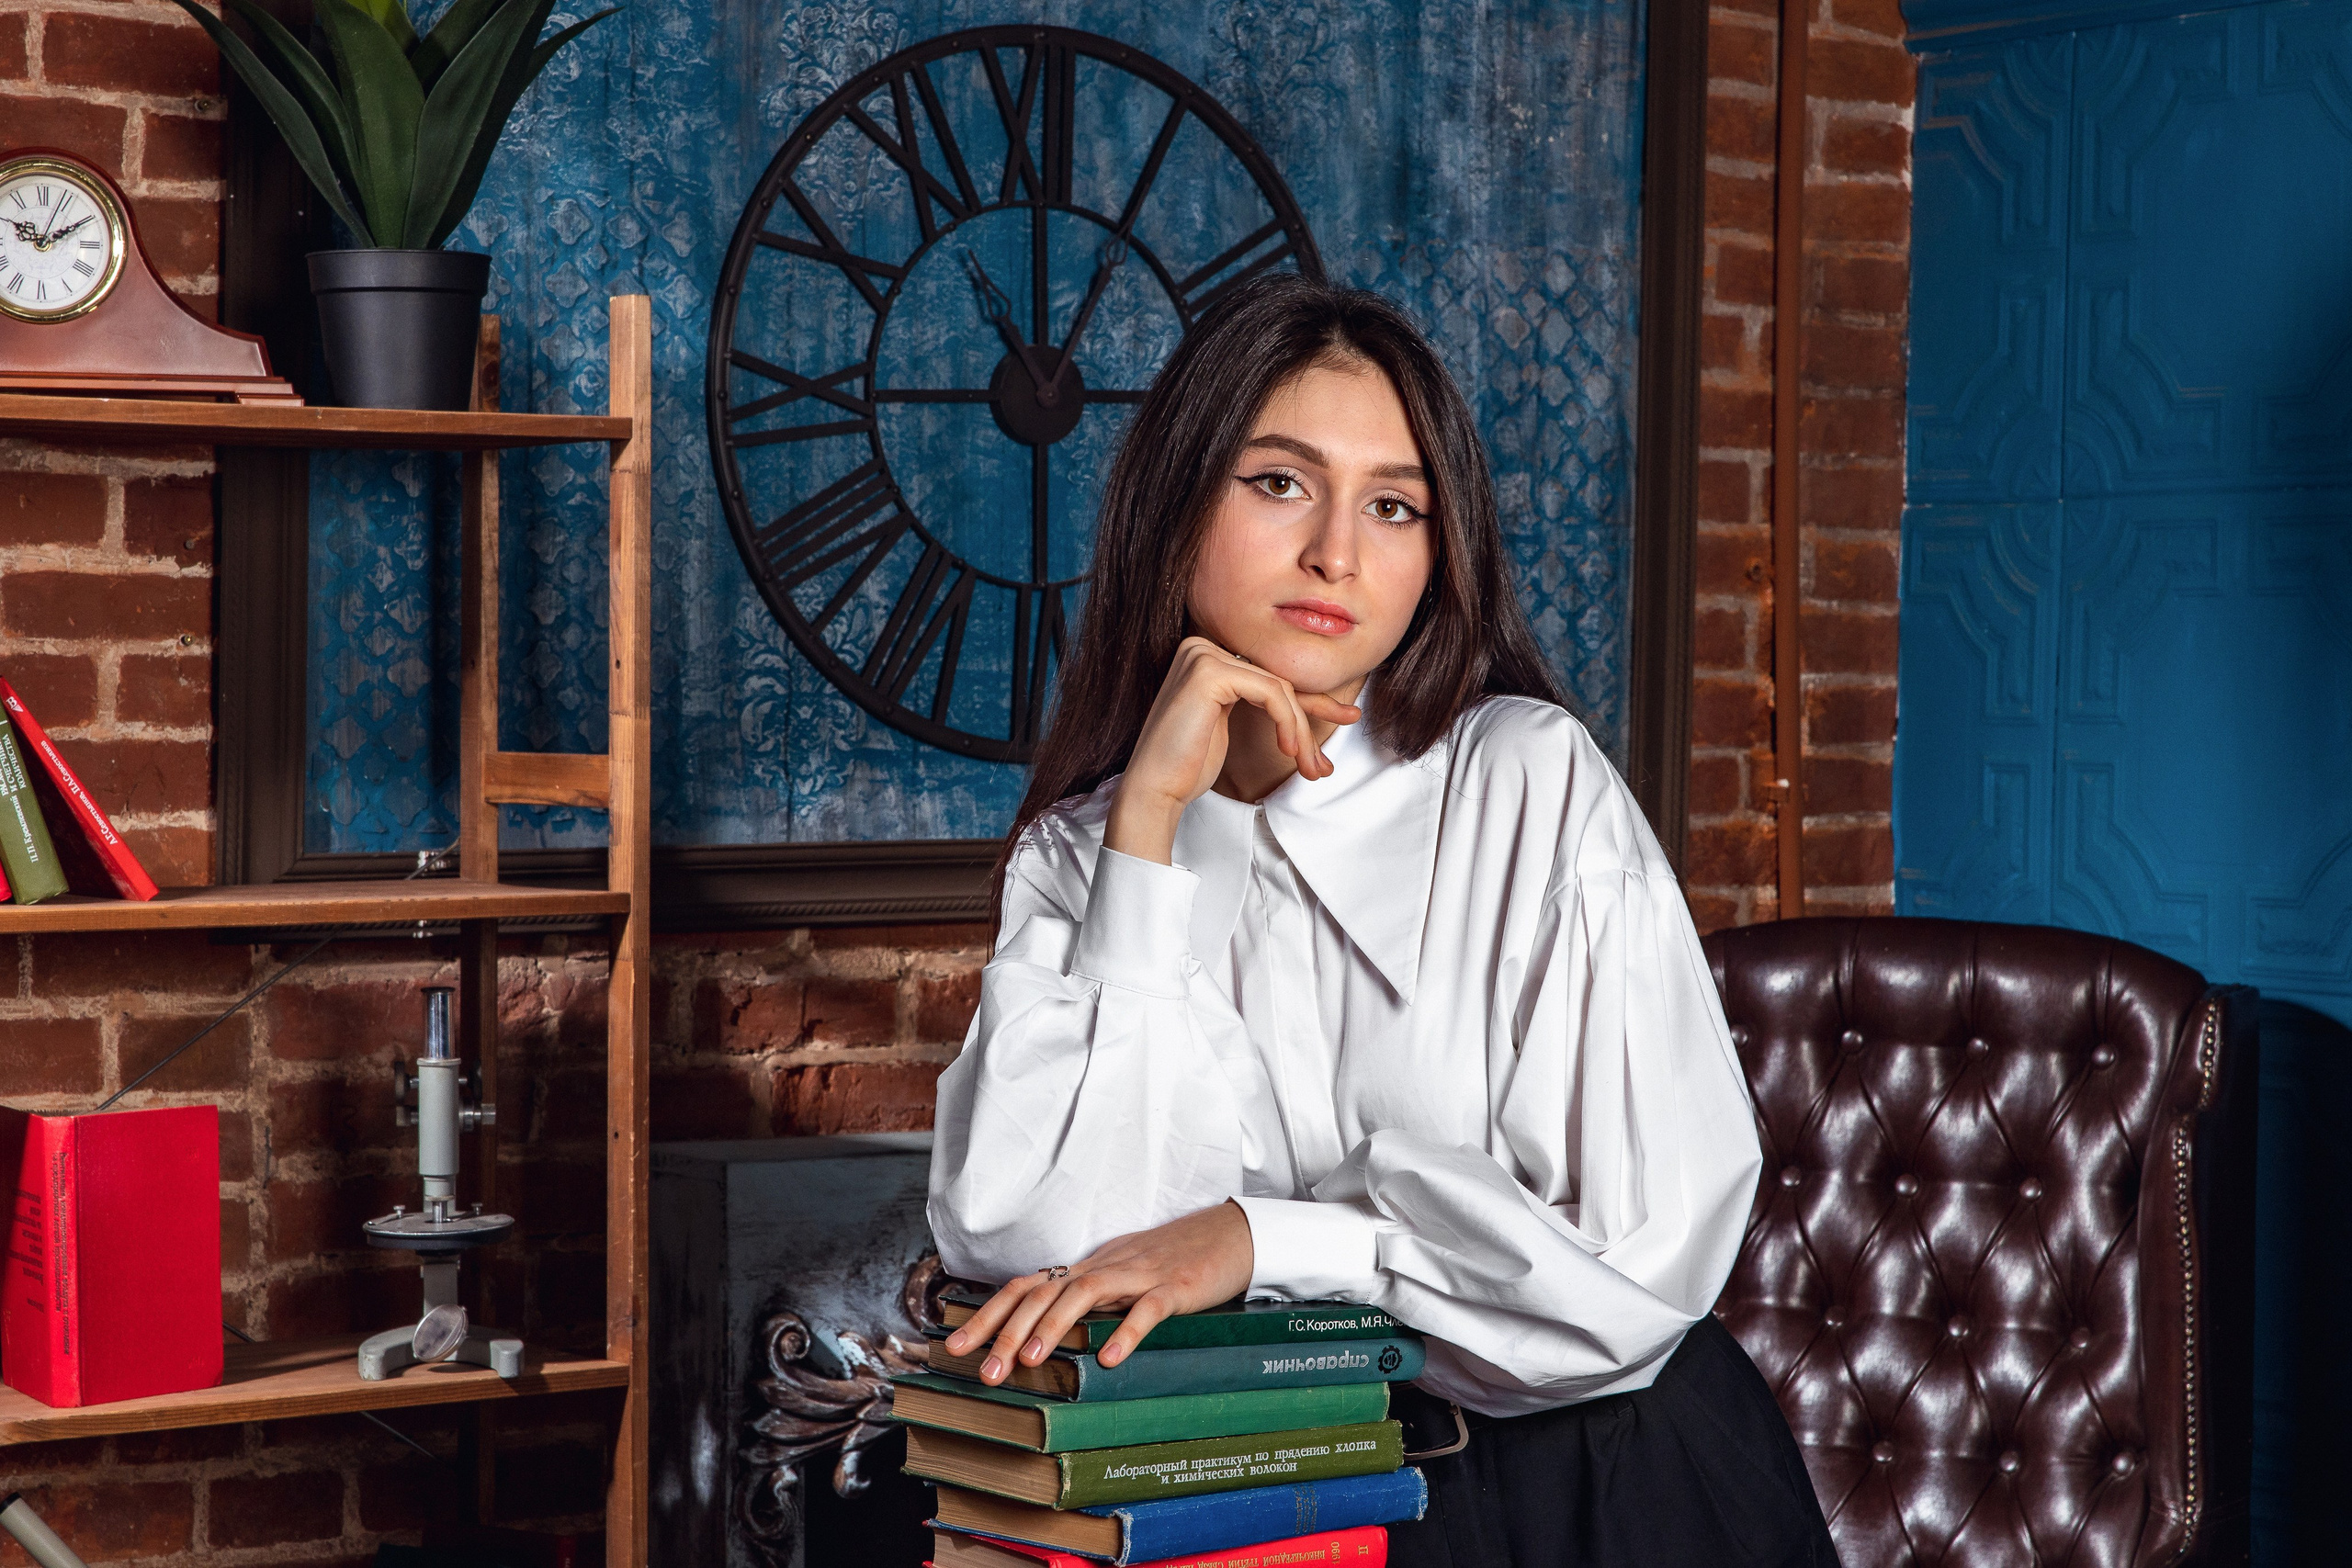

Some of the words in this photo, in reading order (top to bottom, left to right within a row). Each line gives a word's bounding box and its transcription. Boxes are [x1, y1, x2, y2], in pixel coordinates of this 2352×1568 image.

[2, 734, 27, 790] КОЛИЧЕСТВА
[1262, 1349, 1370, 1374] справочник
[1103, 1460, 1188, 1480] Лабораторный
[1192, 1454, 1252, 1471] практикум
[1255, 1451, 1270, 1461] по
[1274, 1445, 1330, 1461] прядению
[1335, 1439, 1377, 1453] хлопка
[1160, 1474, 1170, 1485] и
[1173, 1467, 1245, 1484] химических
[1250, 1461, 1297, 1476] волокон
[1262, 1550, 1326, 1565] ВНЕОЧЕРЕДНОЙ
[1330, 1541, 1340, 1564] 1990
